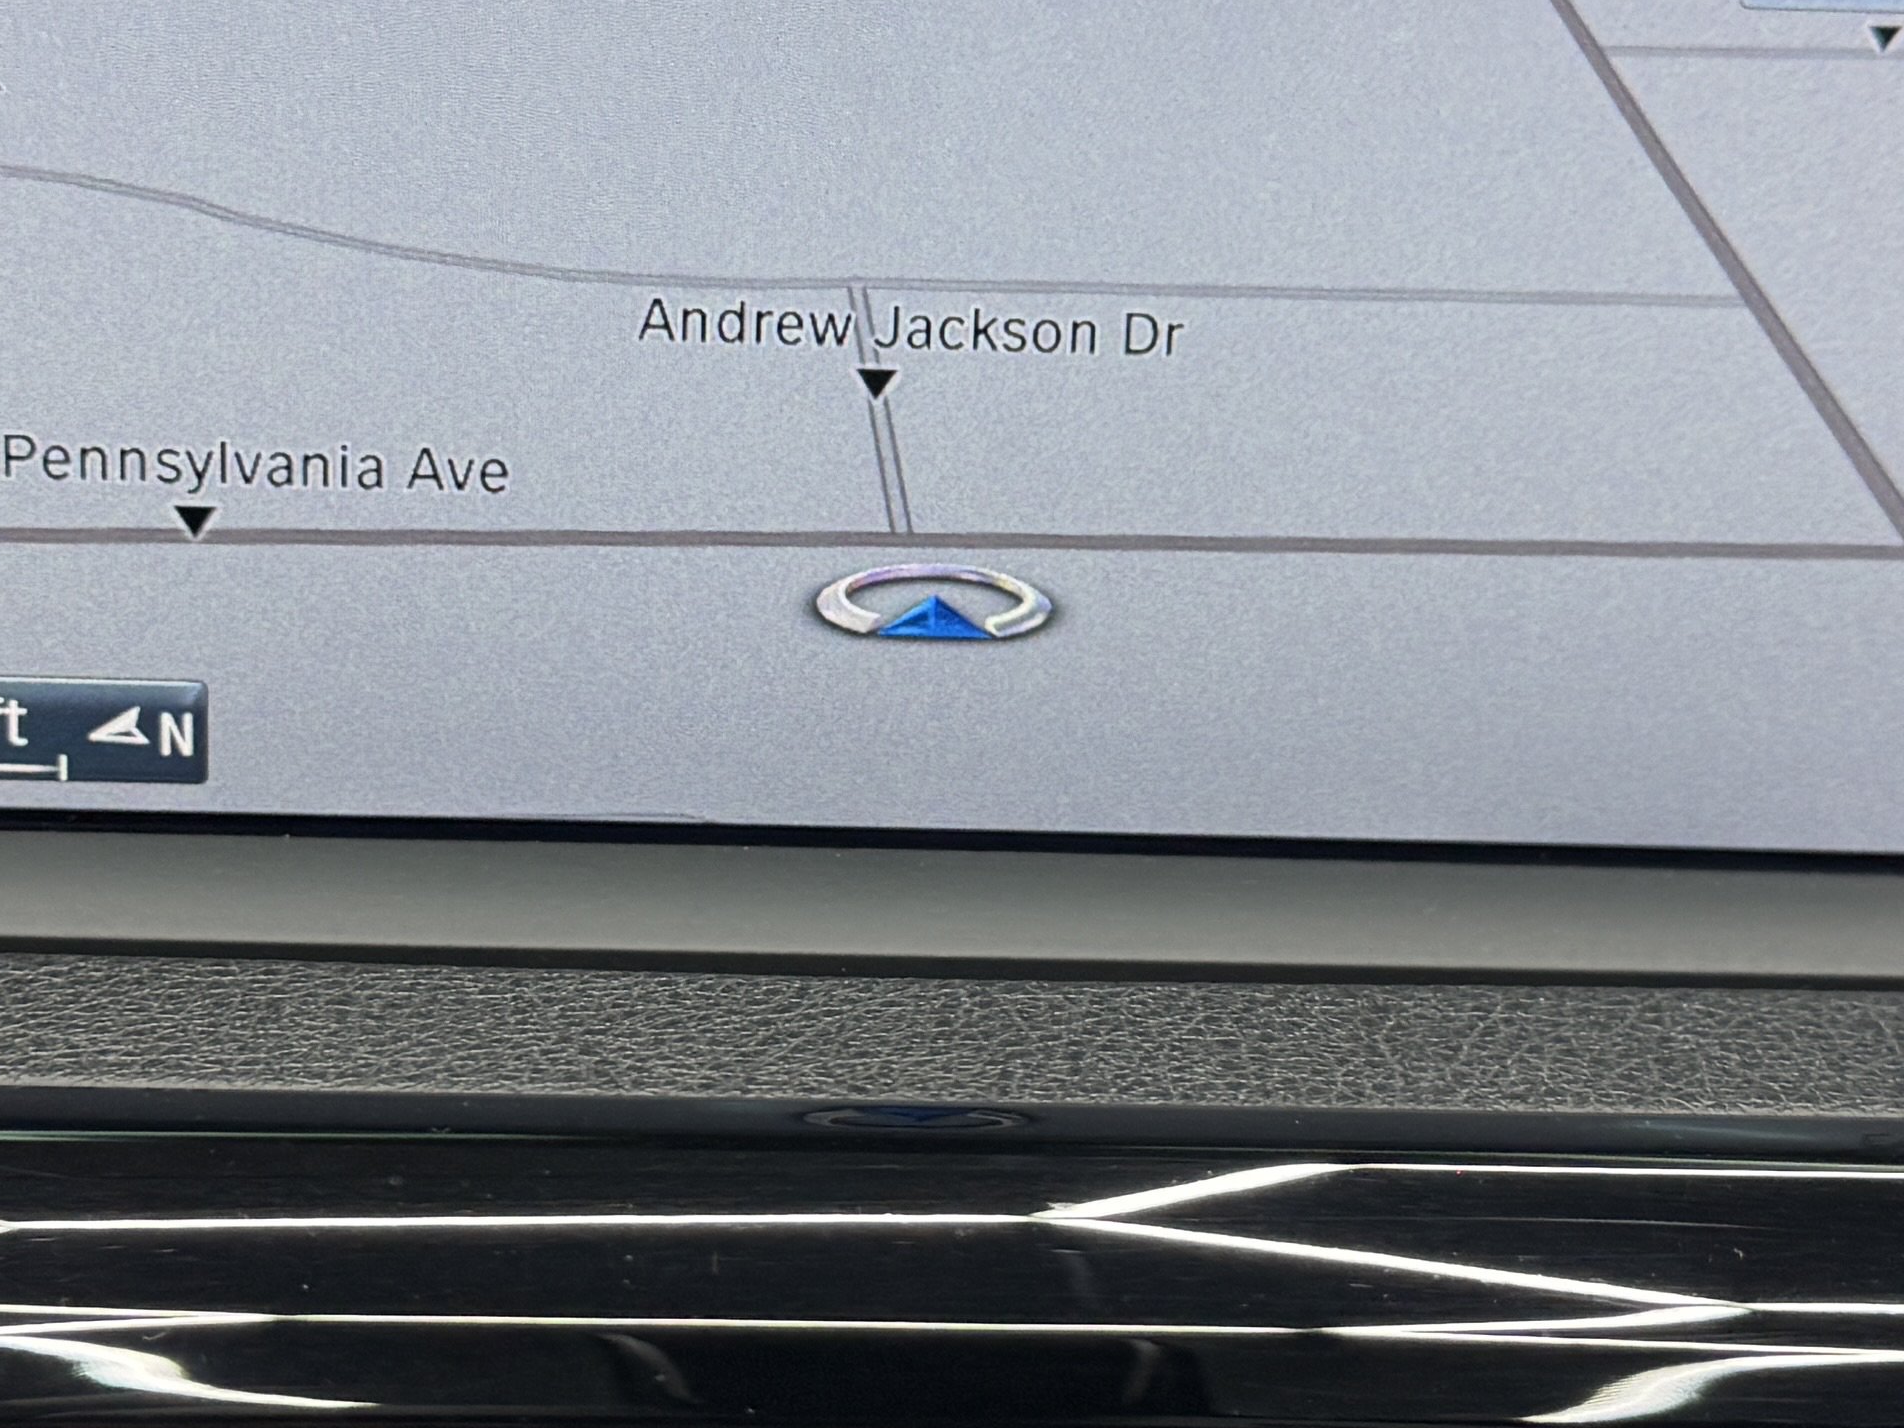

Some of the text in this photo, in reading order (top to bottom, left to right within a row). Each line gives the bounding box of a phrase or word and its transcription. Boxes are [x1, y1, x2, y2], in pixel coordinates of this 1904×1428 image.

[638, 297, 1185, 357] Andrew Jackson Dr
[2, 433, 385, 494] Pennsylvania
[406, 446, 510, 494] Ave
[159, 711, 194, 757] N
